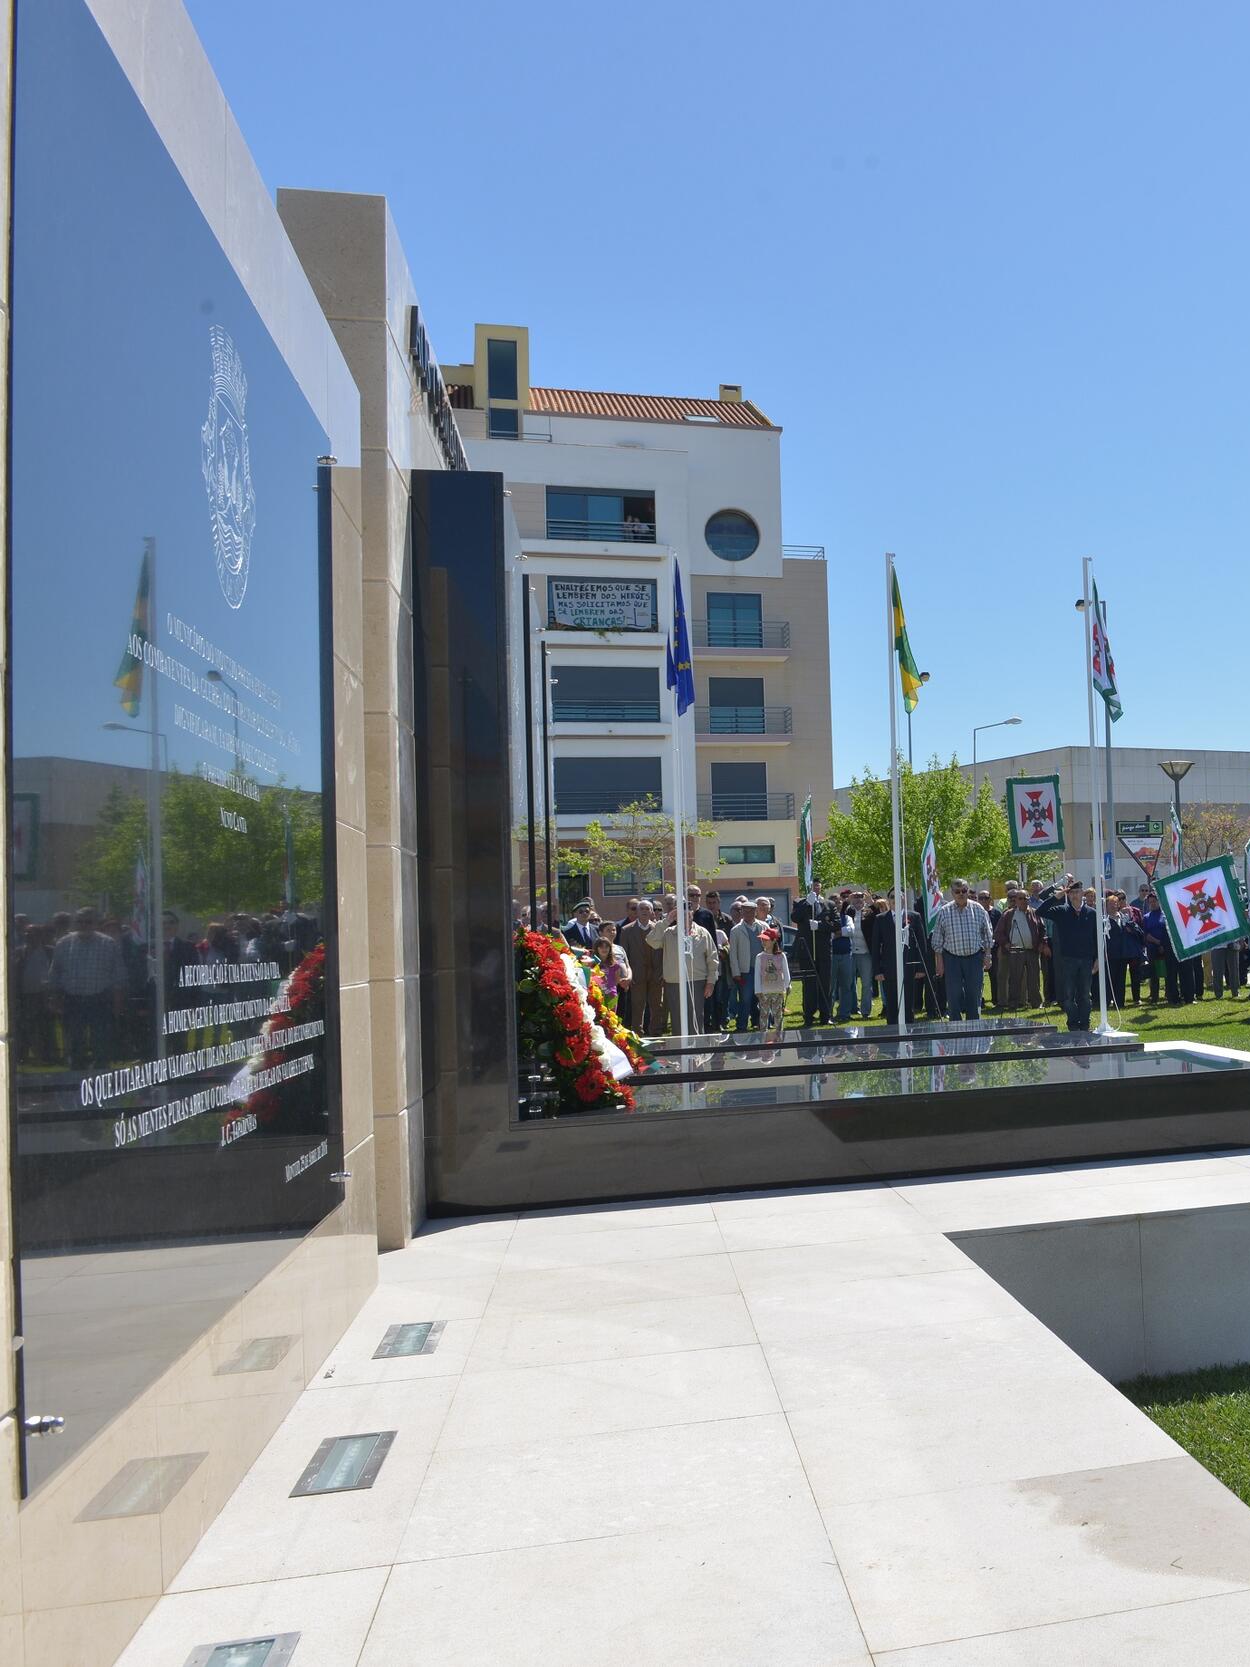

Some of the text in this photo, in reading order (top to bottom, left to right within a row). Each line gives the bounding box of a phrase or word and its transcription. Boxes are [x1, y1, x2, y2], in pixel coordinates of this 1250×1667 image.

[576, 600, 631, 608] SOLICITAMOS
[620, 592, 650, 600] HERÓIS
[570, 608, 605, 616] LEMBREM
[127, 633, 142, 660] AOS
[143, 641, 191, 690] COMBATENTES
[178, 966, 184, 986] A
[184, 962, 223, 987] RECORDAÇÃO
[162, 1011, 167, 1034] A
[168, 1006, 208, 1033] HOMENAGEM
[81, 1077, 93, 1106] OS
[95, 1072, 112, 1104] QUE
[114, 1062, 153, 1096] LUTARAM
[153, 1058, 167, 1084] POR
[167, 1051, 196, 1080] VALORES
[196, 1049, 206, 1071] OU
[114, 1112, 125, 1147] SÓ
[127, 1114, 137, 1142] AS
[138, 1104, 167, 1137] MENTES
[167, 1096, 188, 1125] PURAS
[189, 1089, 210, 1117] ABREM
[210, 1087, 215, 1108] O
